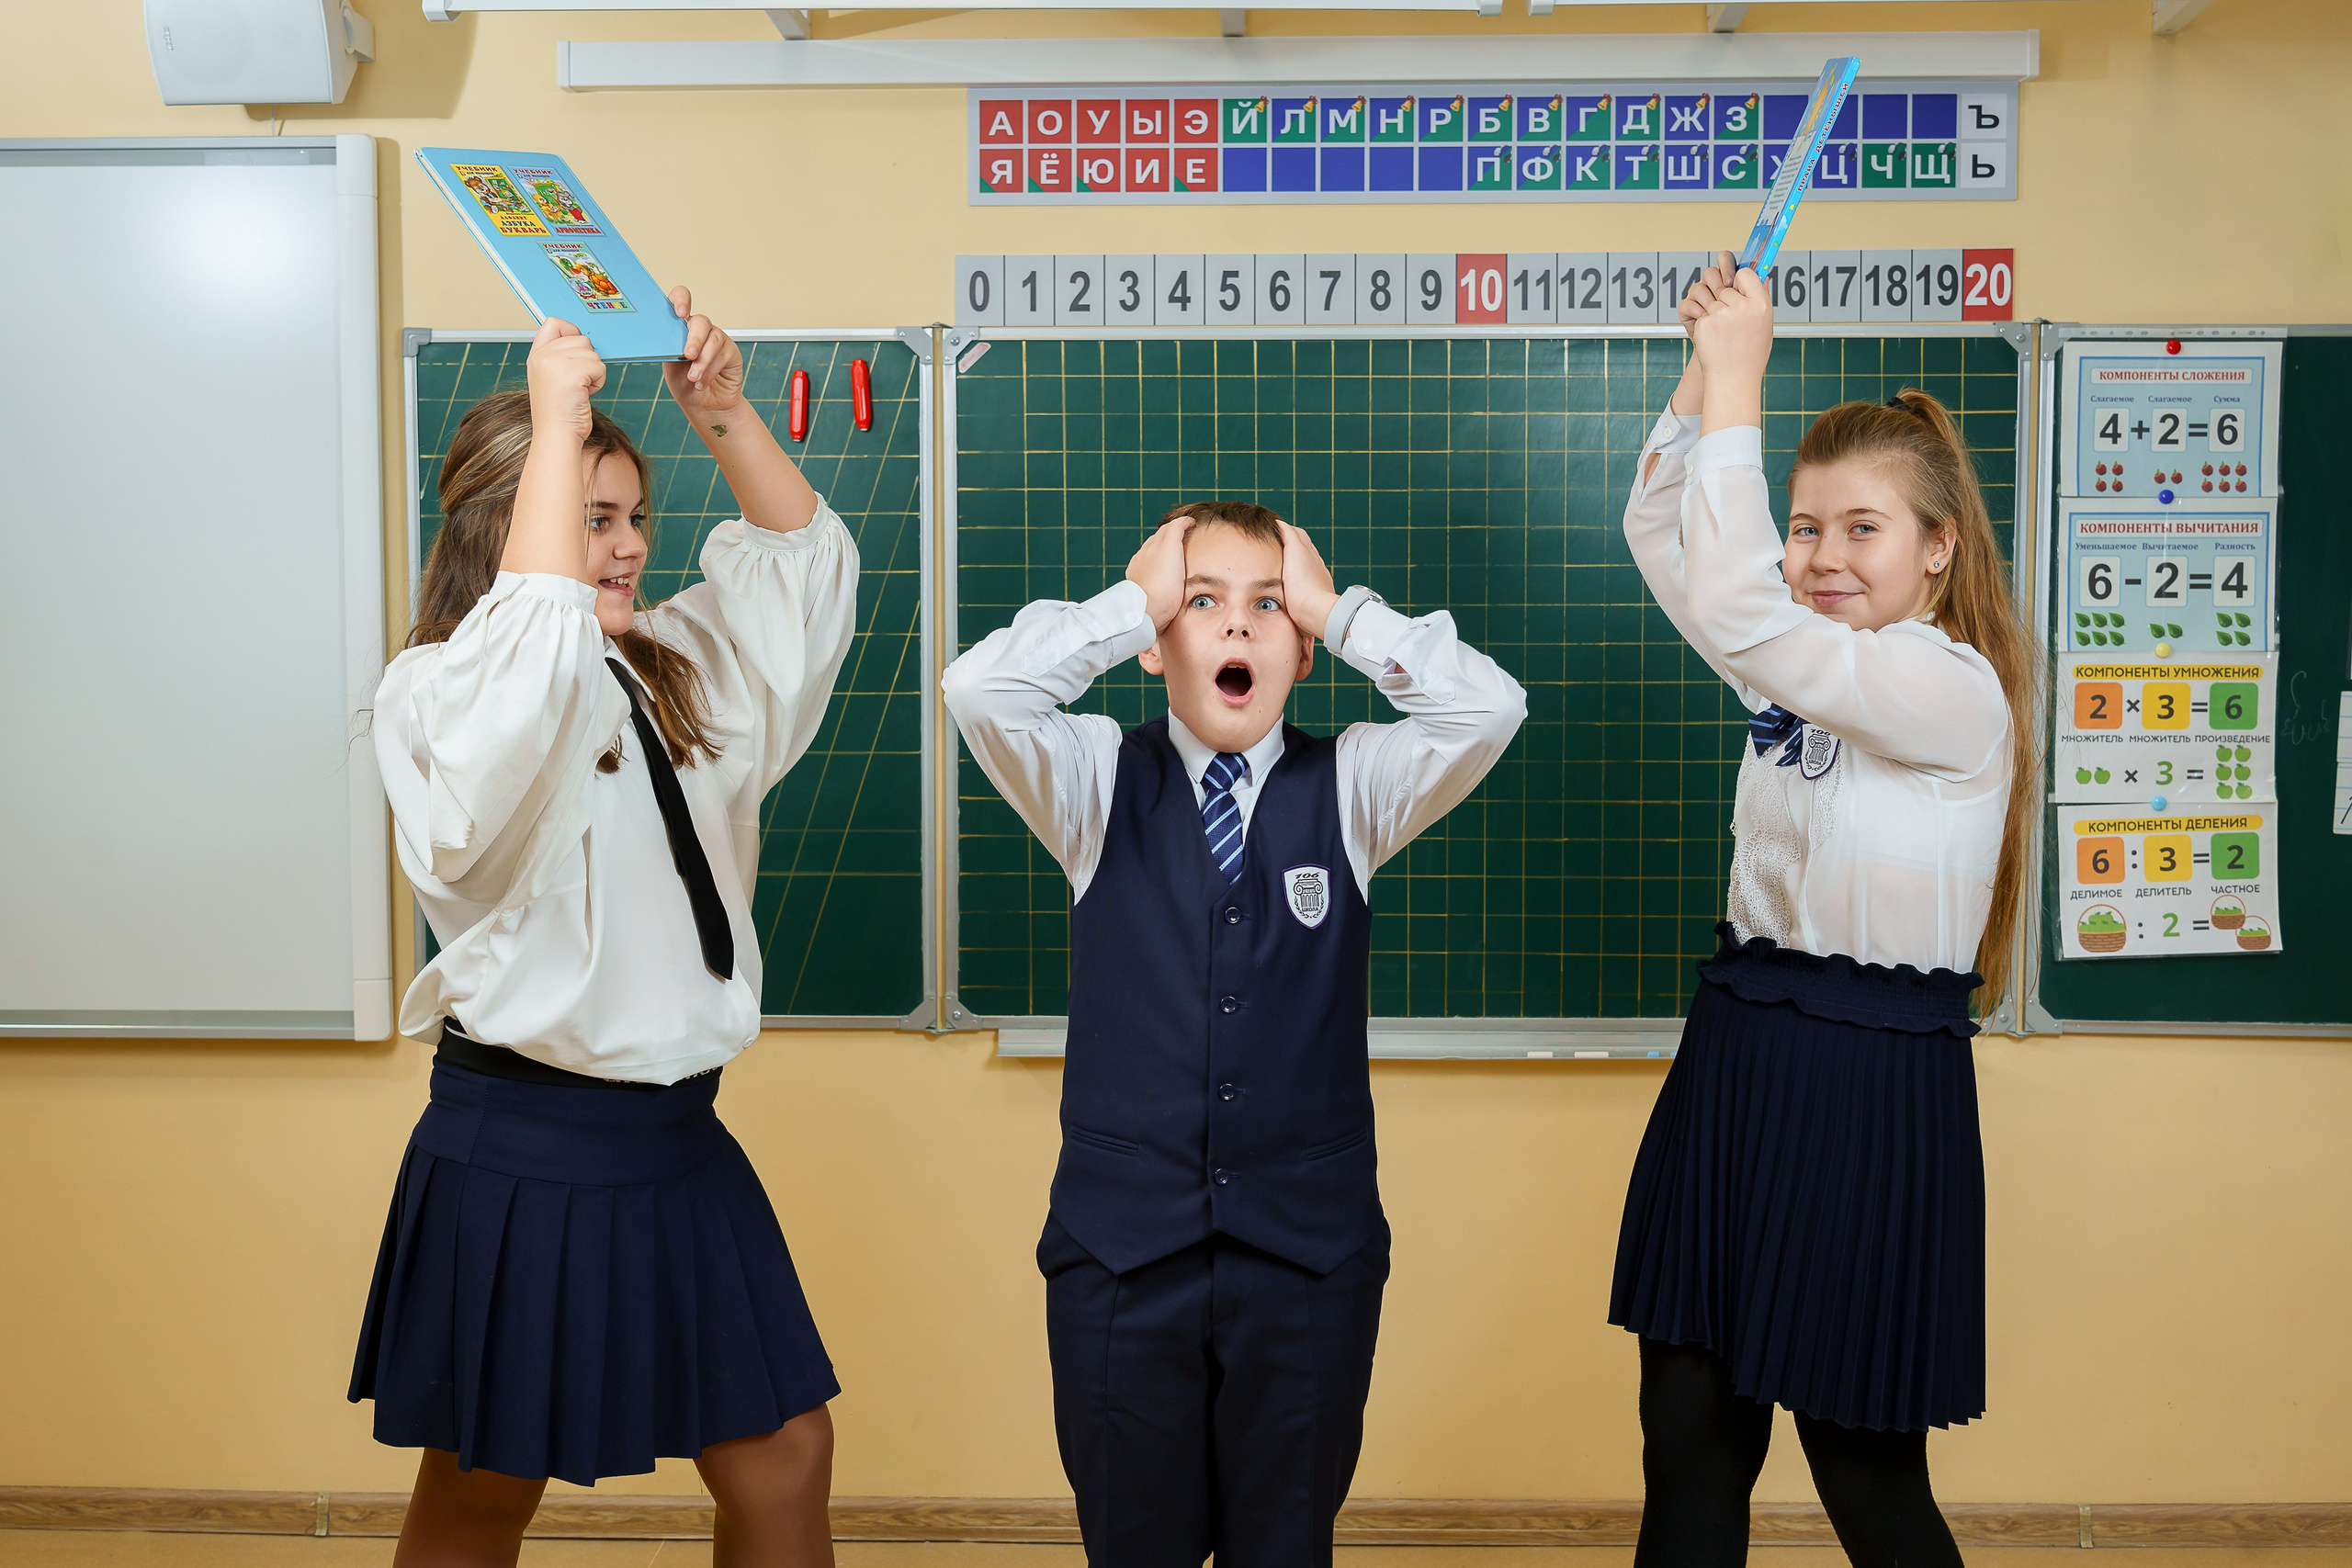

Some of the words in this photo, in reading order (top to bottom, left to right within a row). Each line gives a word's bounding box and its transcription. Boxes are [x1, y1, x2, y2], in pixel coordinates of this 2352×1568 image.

[989, 111, 1014, 136] А
[1036, 110, 1063, 136] О
[1087, 110, 1111, 135] У
[1133, 110, 1162, 135] Ы
[1184, 109, 1209, 135] Э
[1232, 101, 1258, 134] Й
[1280, 109, 1306, 134] Л
[1329, 109, 1357, 134] М
[1379, 109, 1405, 133] Н
[1430, 108, 1453, 133] Р
[1478, 107, 1501, 133] Б
[1528, 107, 1551, 132] В
[1578, 107, 1599, 132] Г
[1623, 107, 1650, 135] Д
[1669, 107, 1705, 131] Ж
[1724, 106, 1747, 131] З
[1968, 104, 2000, 130] Ъ
[1797, 159, 1815, 192] ПРАВА
[1815, 83, 1849, 152] ДЕТЁНЫШЕЙ
[990, 159, 1012, 184] Я
[1040, 152, 1060, 184] Ё
[1083, 158, 1114, 184] Ю
[1135, 159, 1159, 183] И
[1186, 159, 1206, 183] Е
[1476, 156, 1501, 182] П
[1521, 155, 1554, 182] Ф
[1577, 156, 1600, 181] К
[1625, 156, 1647, 181] Т
[1668, 155, 1702, 181] Ш
[1721, 155, 1747, 181] С
[1822, 155, 1849, 184] Ц
[1871, 155, 1893, 180] Ч
[1915, 154, 1951, 184] Щ
[1972, 153, 1996, 178] Ь
[969, 271, 990, 312] 0
[1022, 271, 1037, 312] 1
[1069, 271, 1091, 312] 2
[1119, 271, 1141, 311] 3
[1168, 270, 1192, 311] 4
[1219, 270, 1241, 311] 5
[1269, 270, 1291, 311] 6
[1319, 270, 1341, 311] 7
[1370, 270, 1392, 311] 8
[1419, 269, 1442, 311] 9
[1460, 268, 1504, 311] 10
[1513, 268, 1554, 311] 11
[1563, 268, 1602, 310] 12
[1611, 267, 1654, 310] 13
[1768, 265, 1805, 308] 16
[1814, 265, 1858, 308] 17
[1865, 265, 1908, 307] 18
[1916, 264, 1959, 306] 19
[1964, 263, 2012, 306] 20
[586, 301, 628, 310] ЧТЕНИЕ
[2099, 371, 2179, 381] КОМПОНЕНТЫ
[2182, 370, 2245, 381] СЛОЖЕНИЯ
[2090, 395, 2134, 403] Слагаемое
[2147, 395, 2192, 403] Слагаемое
[2213, 395, 2241, 404] Сумма
[2099, 413, 2122, 445] 4
[2157, 413, 2180, 445] 2
[2217, 413, 2238, 446] 6
[2080, 523, 2173, 534] КОМПОНЕНТЫ
[2176, 523, 2259, 534] ВЫЧИТАНИЯ
[2075, 542, 2137, 551] Уменьшаемое
[2142, 542, 2199, 550] Вычитаемое
[2214, 542, 2256, 550] Разность
[2087, 563, 2112, 600] 6
[2154, 562, 2179, 598] 2
[2221, 561, 2248, 598] 4
[2075, 667, 2170, 678] КОМПОНЕНТЫ
[2173, 667, 2259, 678] УМНОЖЕНИЯ
[2089, 694, 2107, 719] 2
[2157, 694, 2175, 719] 3
[2224, 694, 2243, 720] 6
[2061, 735, 2123, 743] МНОЖИТЕЛЬ
[2129, 735, 2190, 743] МНОЖИТЕЛЬ
[2195, 735, 2270, 744] ПРОИЗВЕДЕНИЕ
[2155, 761, 2173, 785] 3
[2088, 819, 2182, 833] КОМПОНЕНТЫ
[2185, 818, 2247, 831] ДЕЛЕНИЯ
[2092, 849, 2109, 874] 6
[2159, 847, 2177, 872] 3
[2226, 844, 2245, 870] 2
[2070, 889, 2122, 900] ДЕЛИМОЕ
[2135, 887, 2191, 898] ДЕЛИТЕЛЬ
[2211, 885, 2260, 895] ЧАСТНОЕ
[2162, 913, 2180, 938] 2
